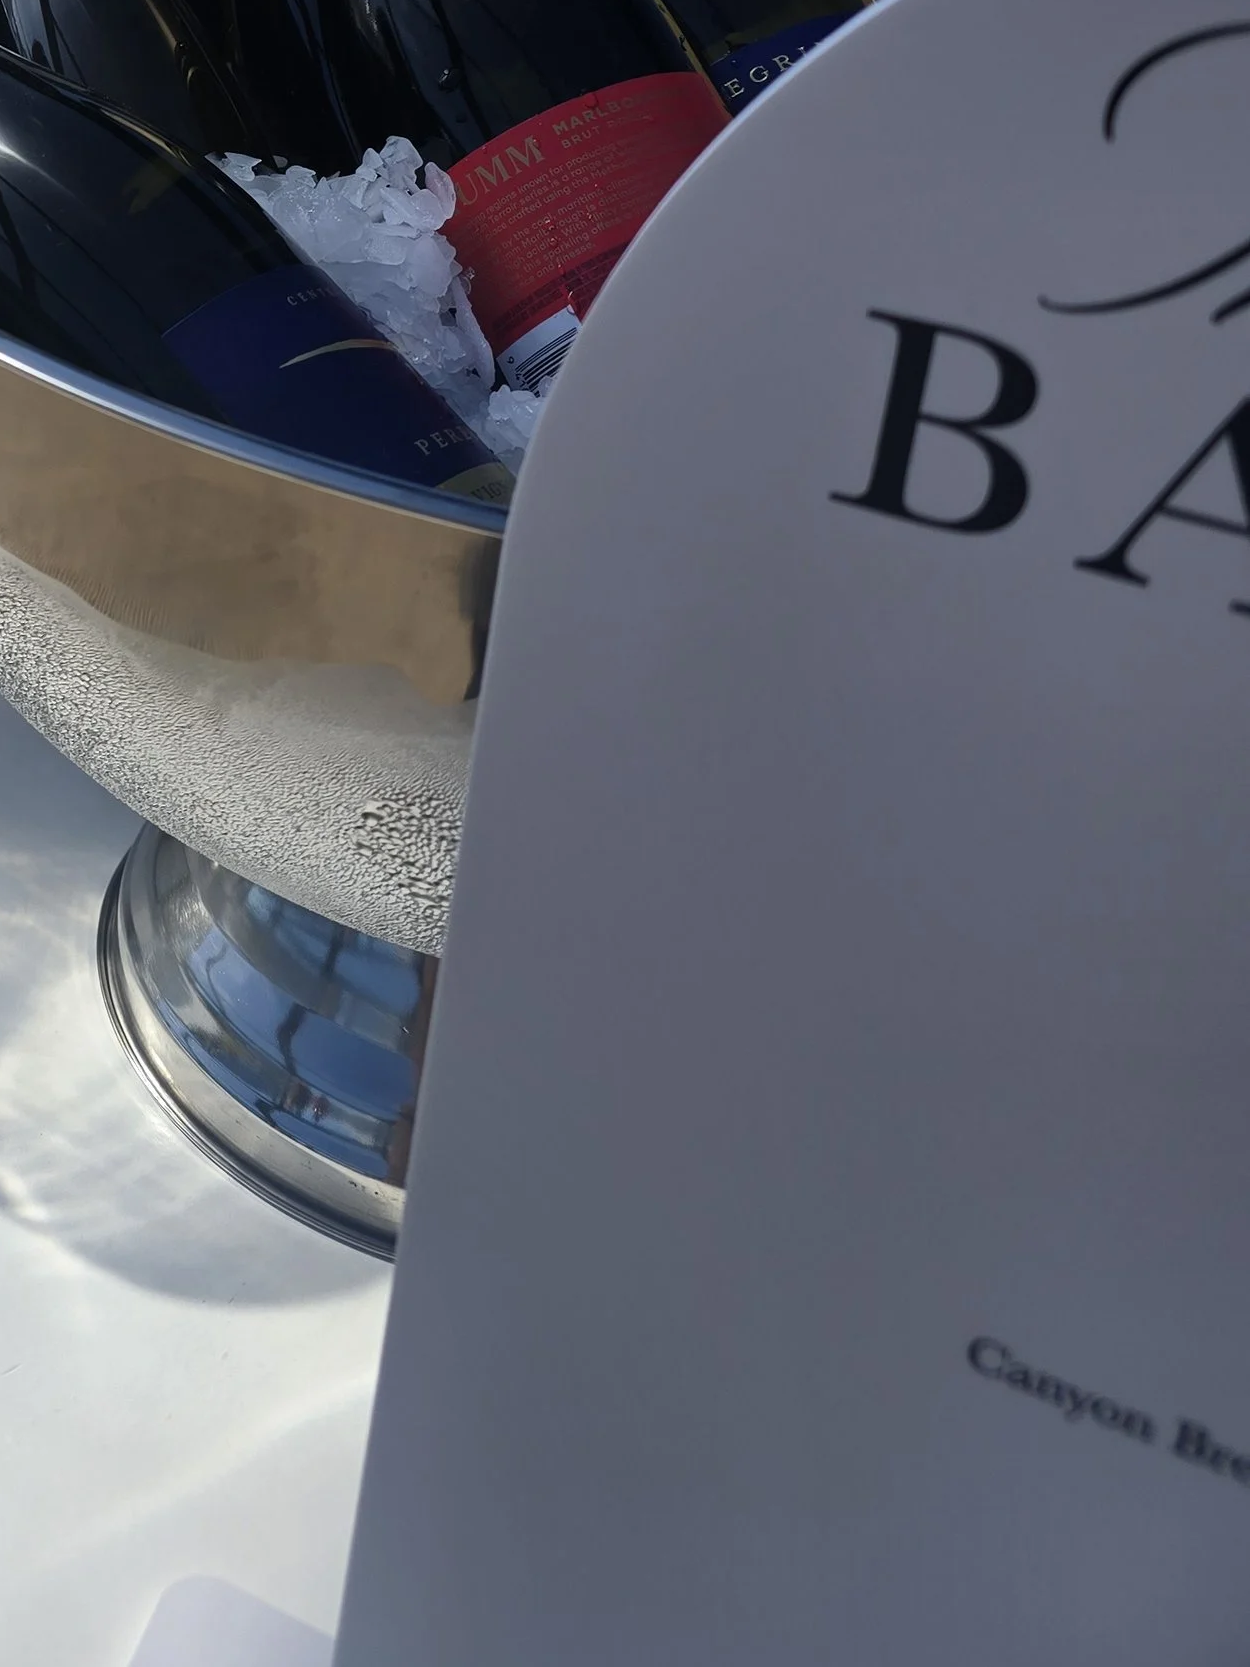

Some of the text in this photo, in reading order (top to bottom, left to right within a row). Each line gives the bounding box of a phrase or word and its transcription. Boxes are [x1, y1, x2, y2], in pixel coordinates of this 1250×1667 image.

[561, 126, 603, 151] BRUT
[453, 135, 546, 207] UMM
[517, 172, 549, 195] known
[966, 1336, 1156, 1445] Canyon
